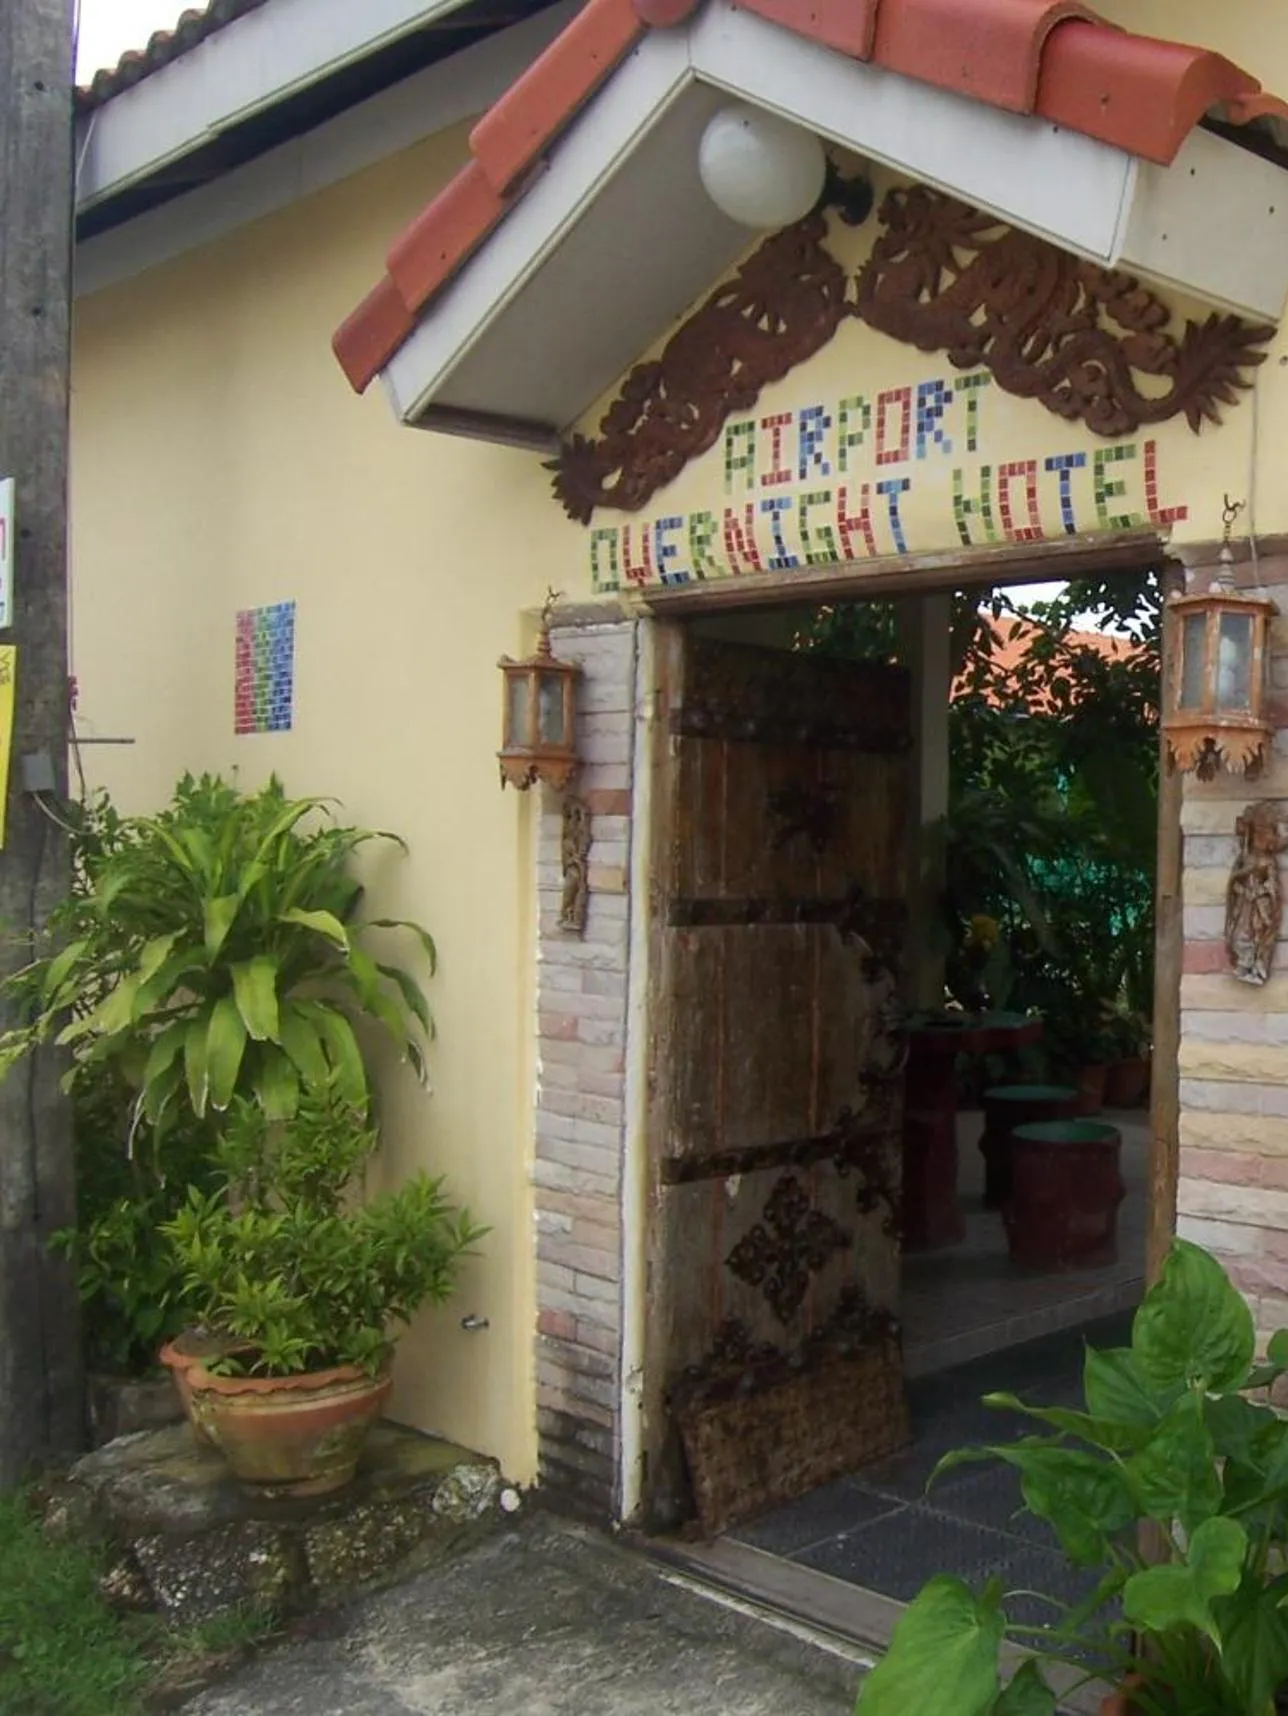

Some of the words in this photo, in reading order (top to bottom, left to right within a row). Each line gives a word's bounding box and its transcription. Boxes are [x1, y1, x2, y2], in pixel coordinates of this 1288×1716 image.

[724, 370, 991, 495] AIRPORT
[590, 477, 911, 595] OVERNIGHT
[952, 438, 1189, 547] HOTEL
